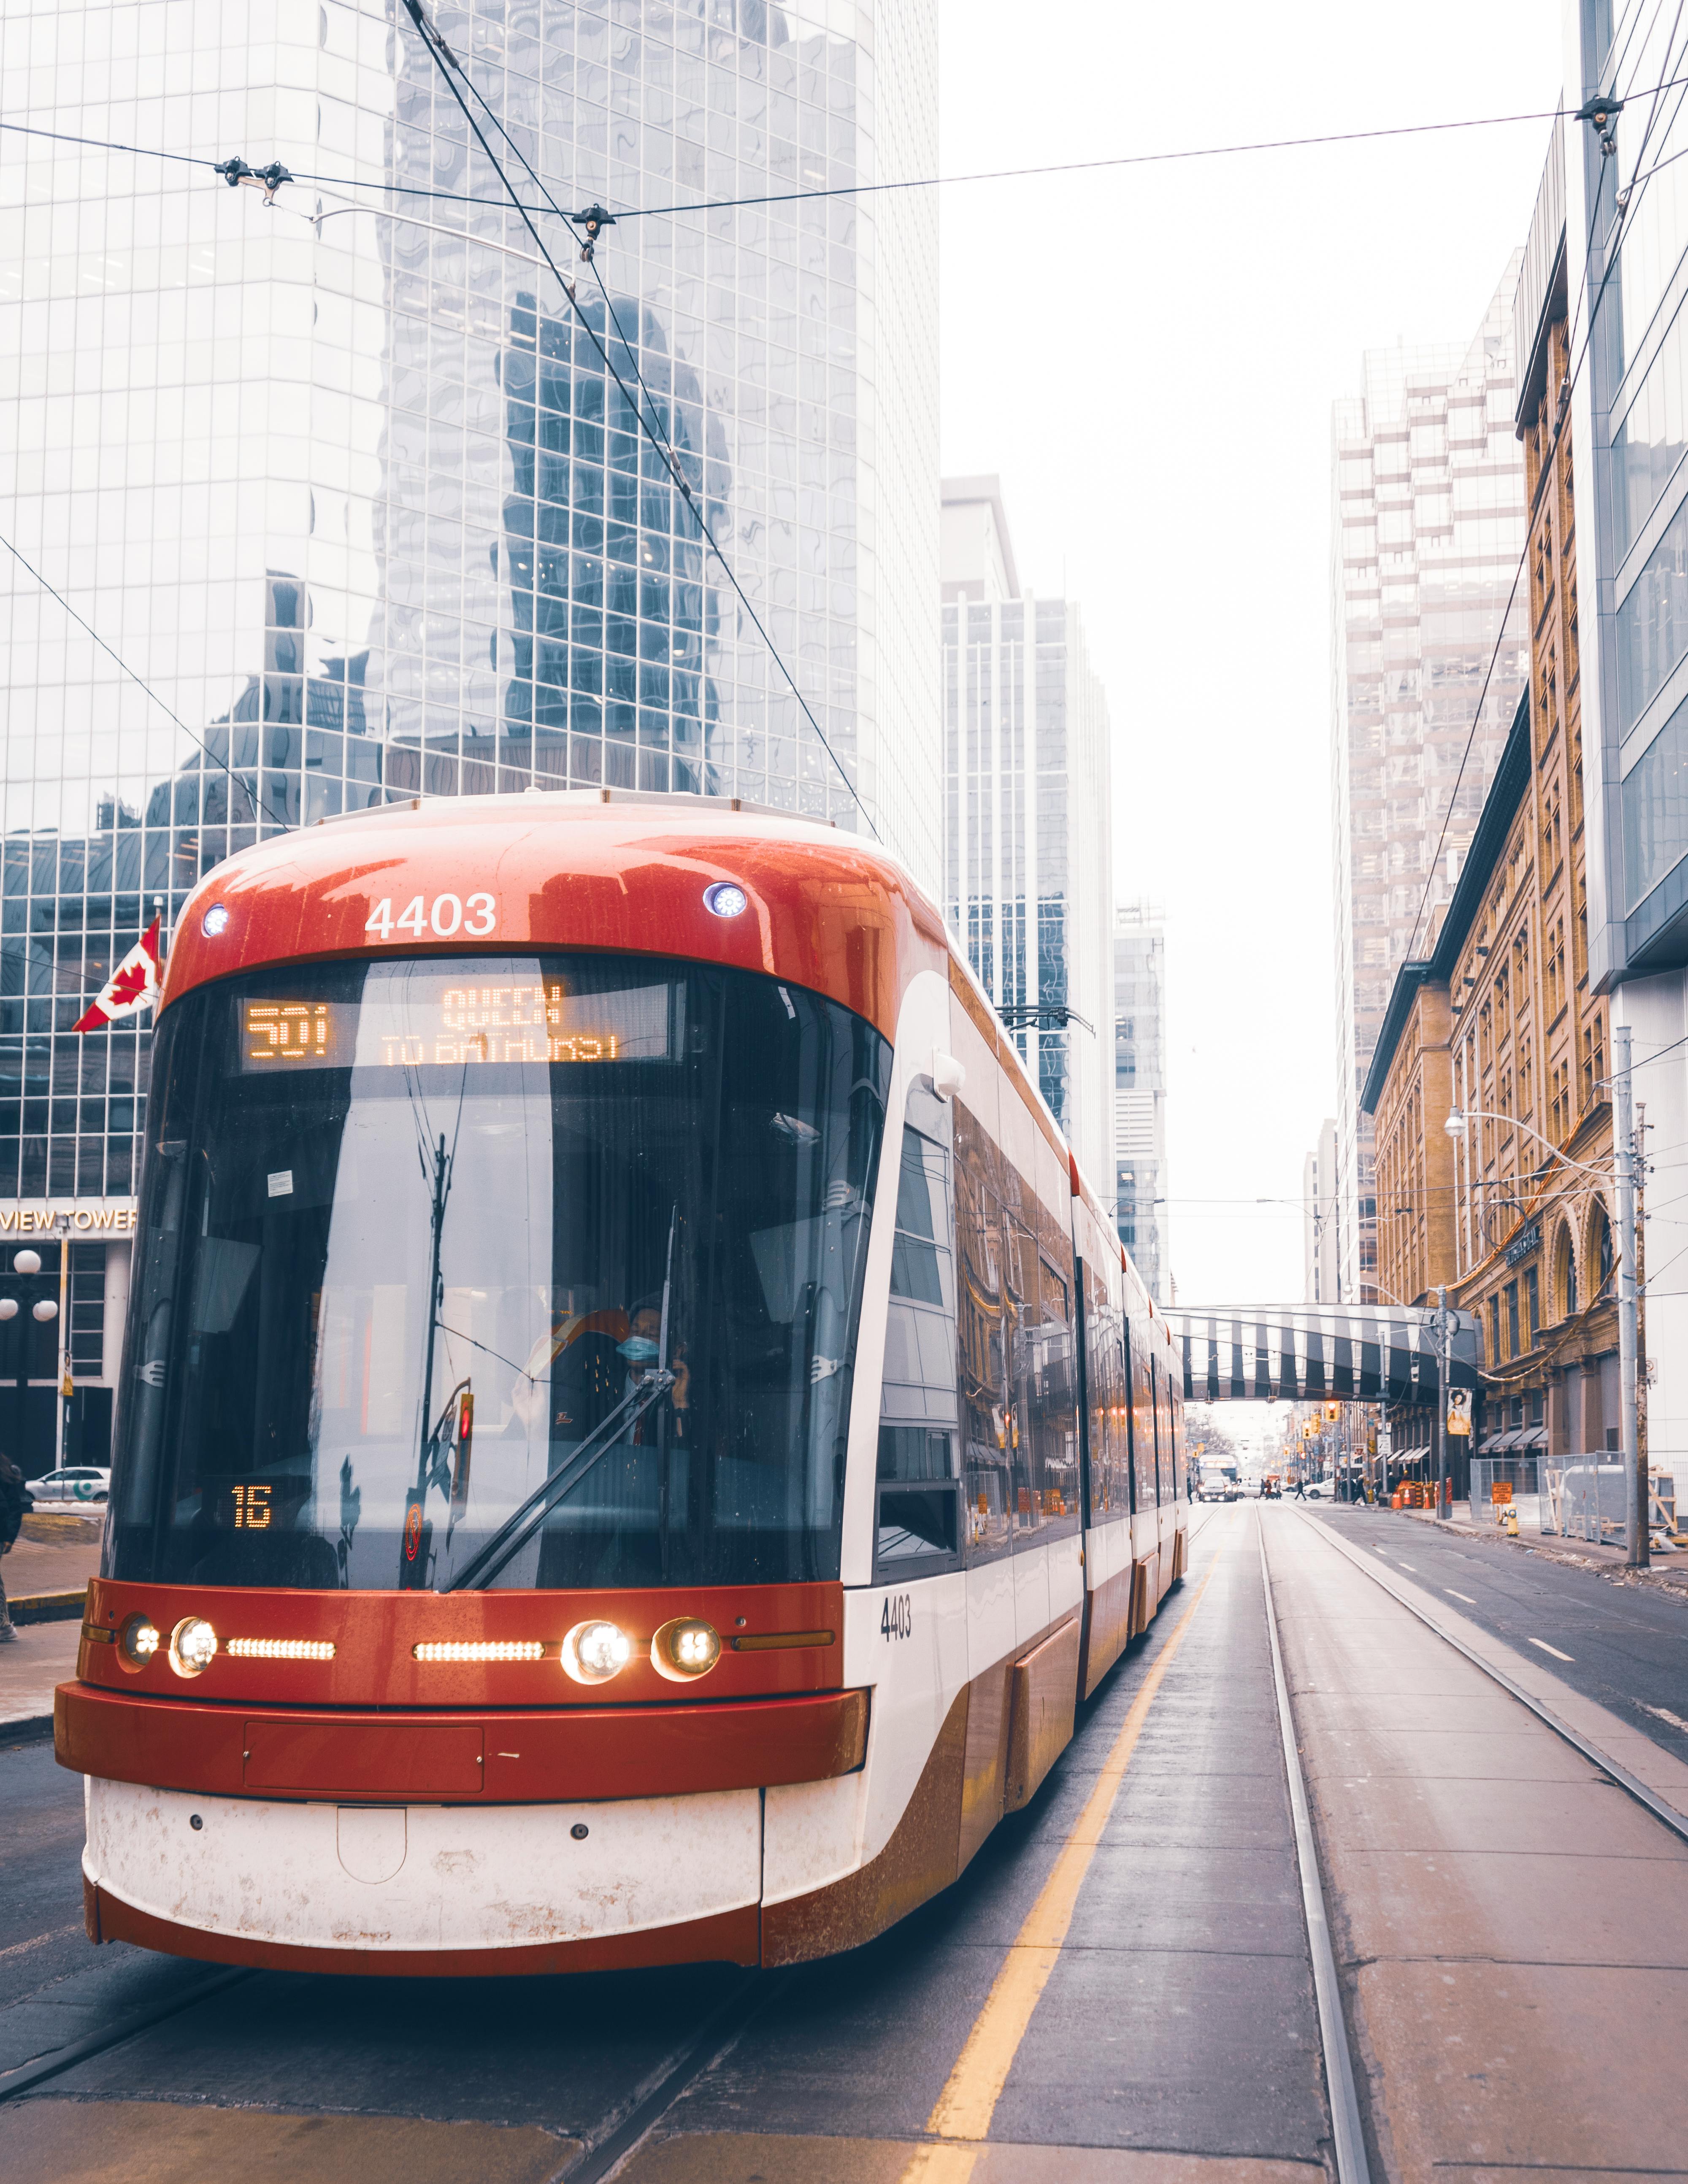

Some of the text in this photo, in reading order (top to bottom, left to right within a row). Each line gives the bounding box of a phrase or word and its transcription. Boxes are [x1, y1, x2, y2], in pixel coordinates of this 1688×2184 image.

[364, 892, 496, 939] 4403
[443, 986, 561, 1031] QUEEN
[249, 1006, 327, 1057] 501
[381, 1035, 422, 1066] TO
[0, 1210, 56, 1230] VIEW
[231, 1485, 272, 1528] 16
[880, 1593, 911, 1643] 4403
